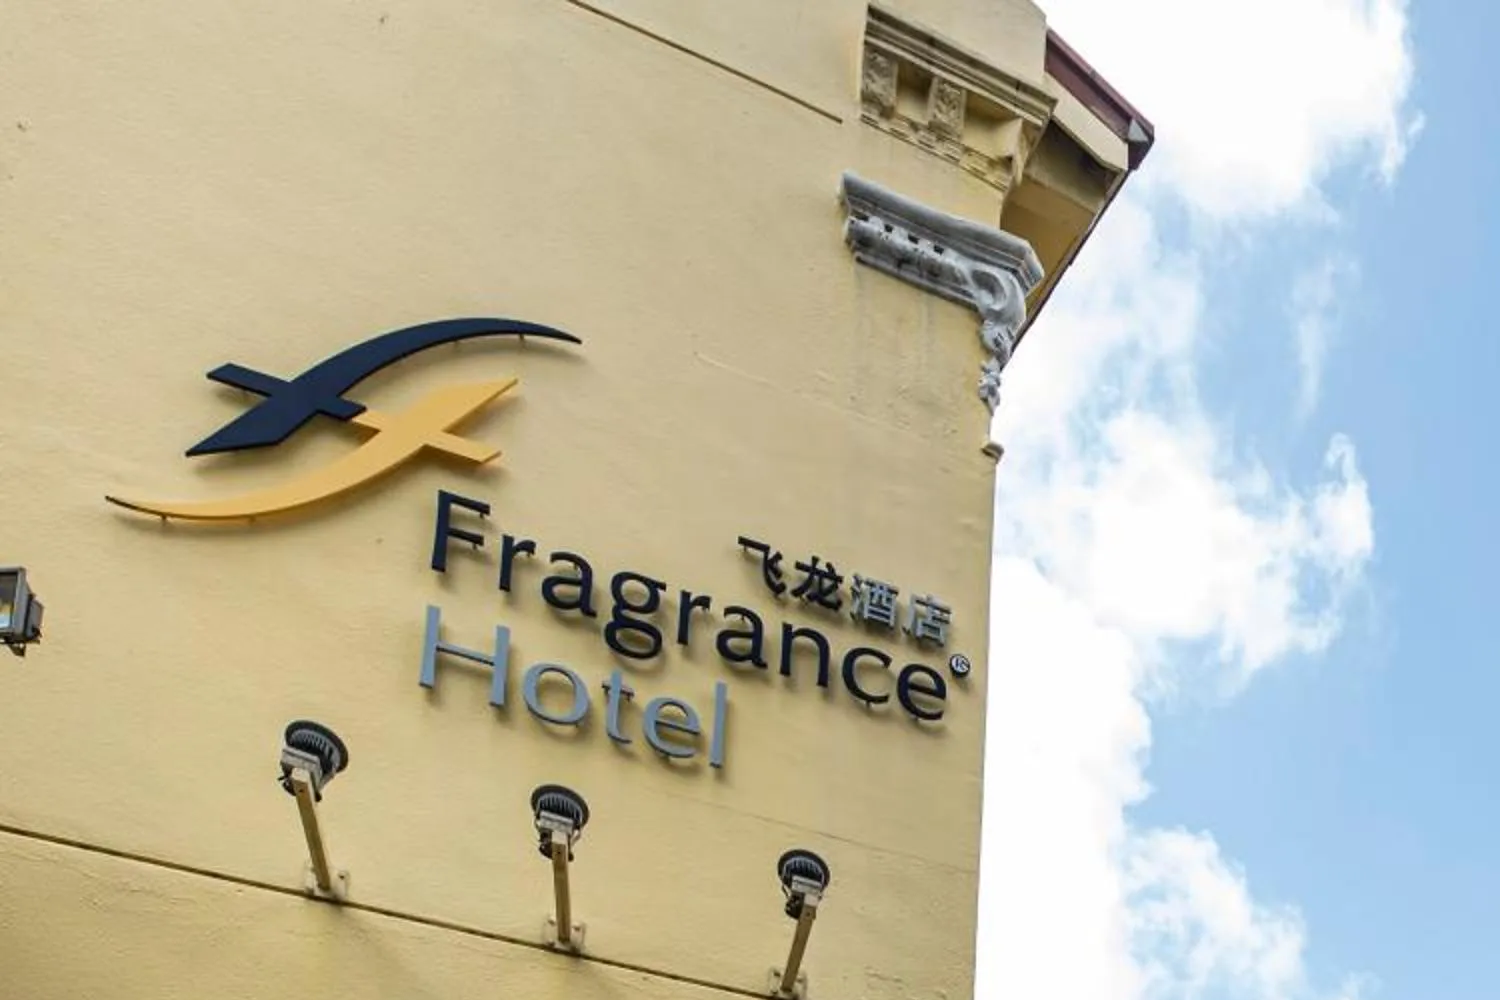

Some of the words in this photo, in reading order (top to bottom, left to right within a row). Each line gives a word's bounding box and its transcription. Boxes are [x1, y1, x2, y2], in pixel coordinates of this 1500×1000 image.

[431, 488, 948, 721] Fragrance
[737, 535, 953, 648] 飞龙酒店
[418, 604, 729, 770] Hotel
